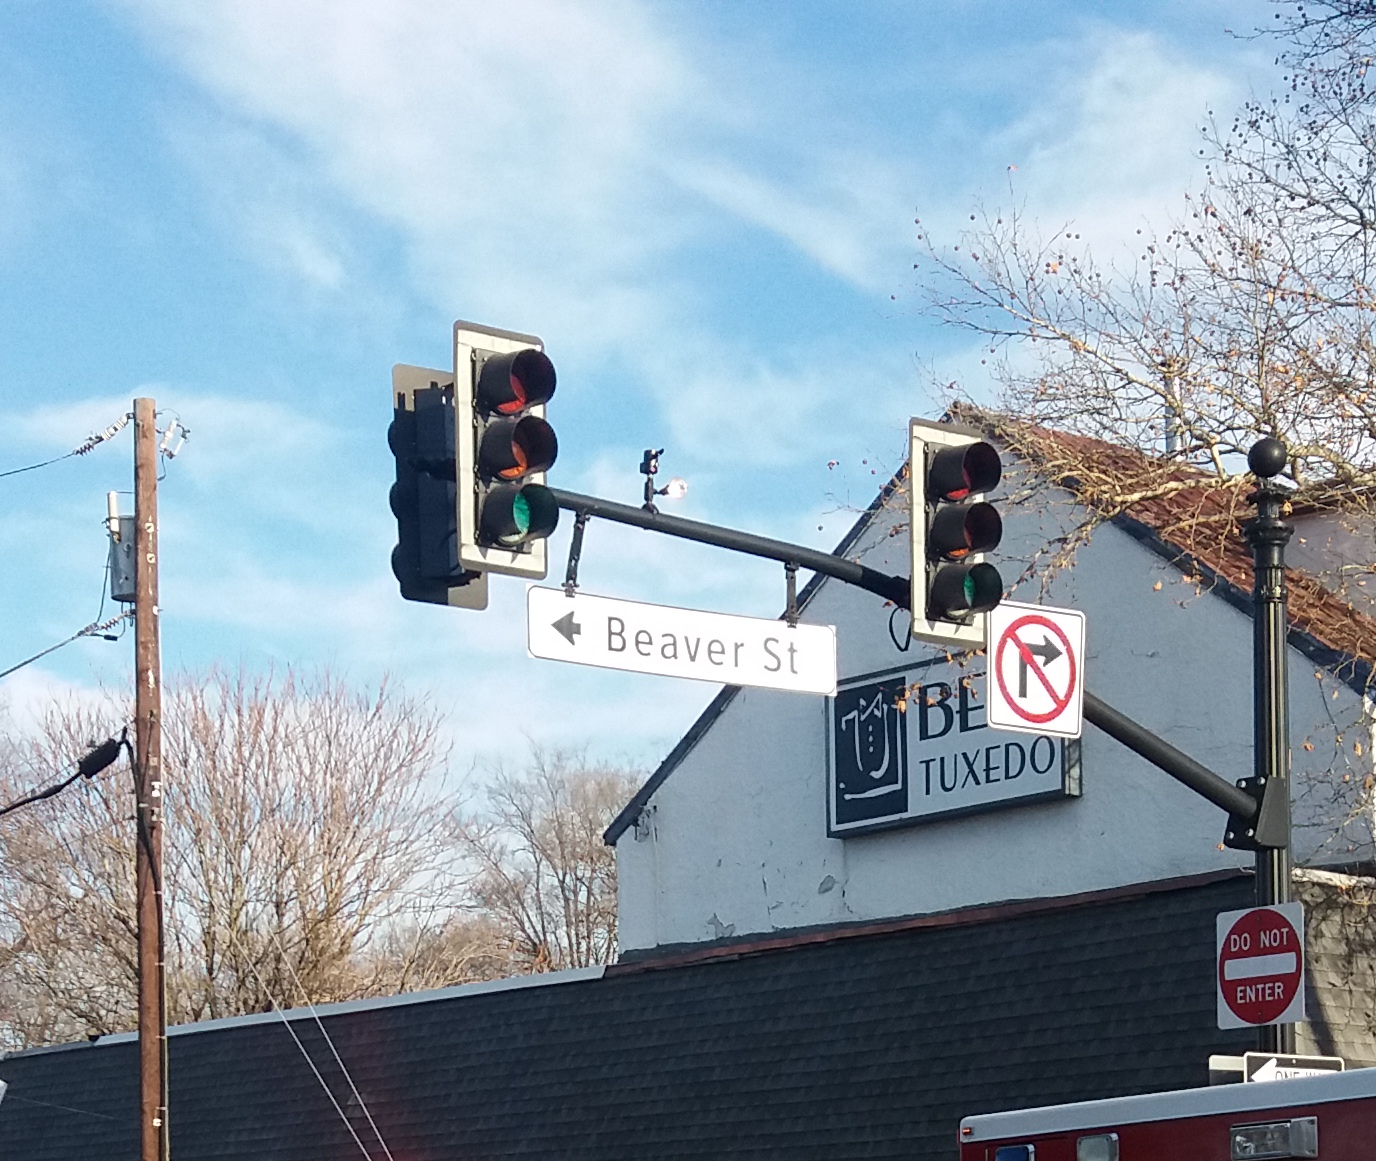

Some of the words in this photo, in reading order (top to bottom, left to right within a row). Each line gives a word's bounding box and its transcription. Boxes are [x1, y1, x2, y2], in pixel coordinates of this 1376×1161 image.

[607, 616, 745, 668] Beaver
[763, 637, 799, 675] St
[918, 735, 1056, 796] TUXEDO
[1230, 933, 1251, 952] DO
[1260, 928, 1289, 948] NOT
[1236, 982, 1284, 1004] ENTER
